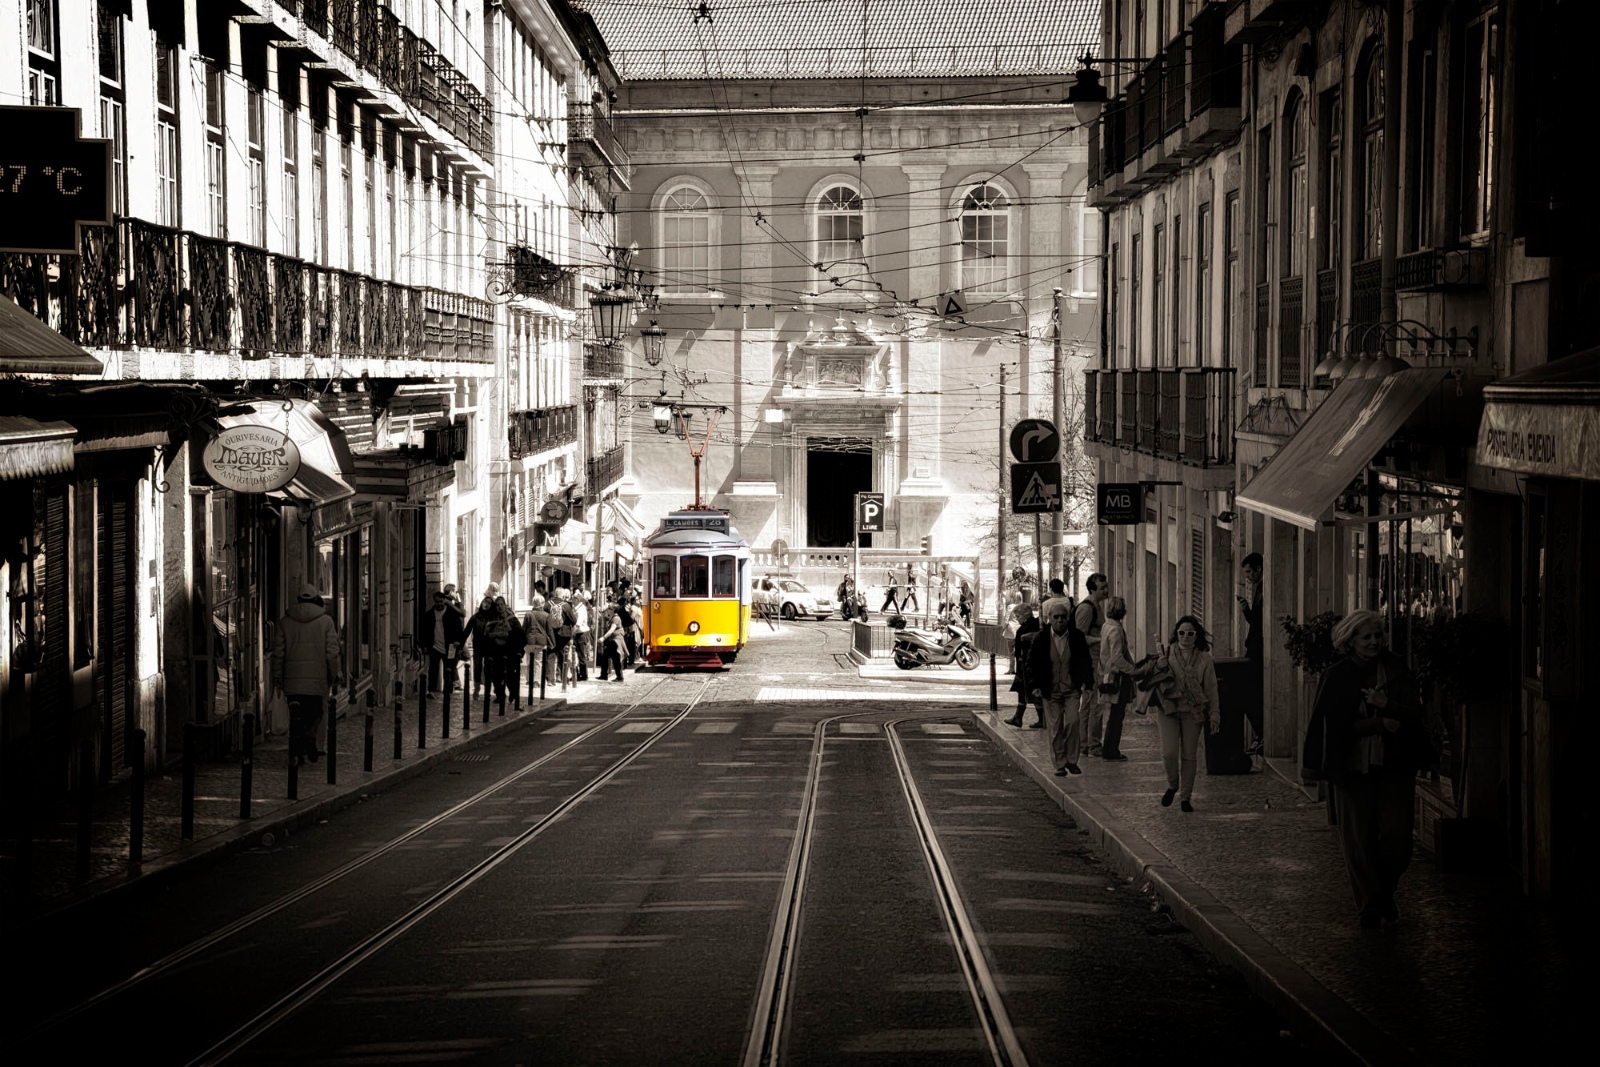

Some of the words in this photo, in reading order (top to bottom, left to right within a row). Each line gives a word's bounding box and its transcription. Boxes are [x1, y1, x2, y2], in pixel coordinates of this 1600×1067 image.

[225, 433, 278, 447] OURIVESARIA
[1527, 433, 1557, 464] EMENDA
[213, 444, 289, 470] MAYER
[220, 470, 279, 487] ANTIGUIDADES
[1105, 494, 1132, 508] MB
[865, 503, 879, 523] P
